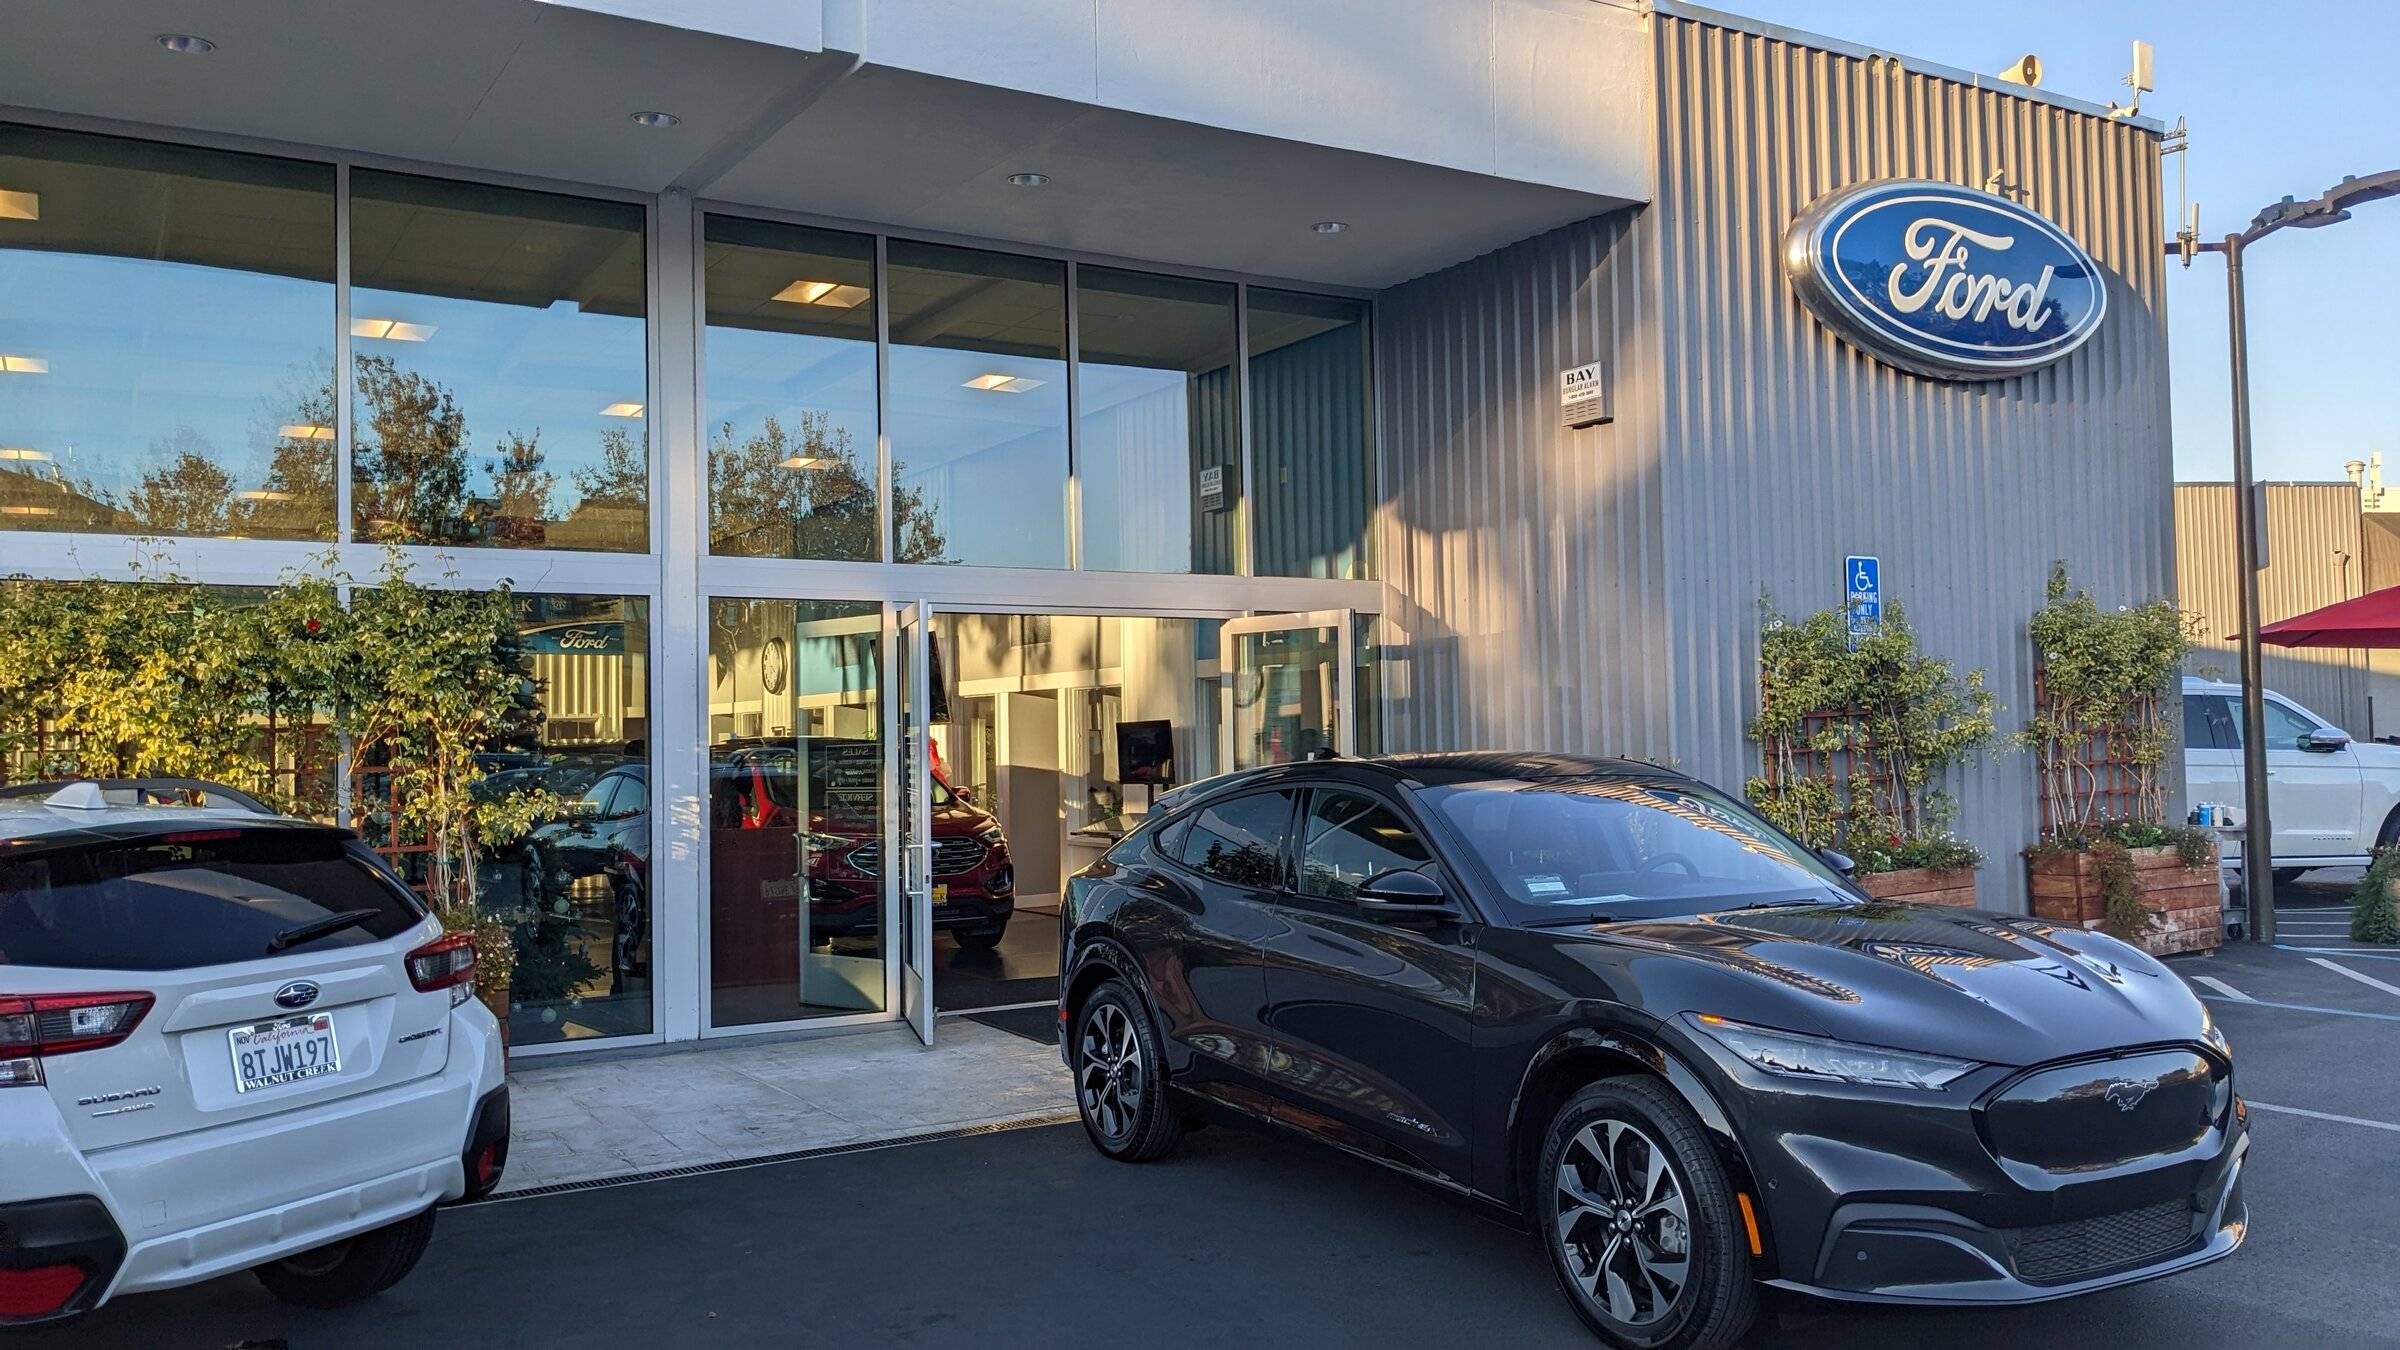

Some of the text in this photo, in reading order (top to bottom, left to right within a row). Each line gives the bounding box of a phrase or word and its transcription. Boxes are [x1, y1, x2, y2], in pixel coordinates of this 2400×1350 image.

[1888, 217, 2055, 333] Ford
[1566, 367, 1596, 385] BAY
[1850, 591, 1878, 604] PARKING
[1856, 604, 1873, 616] ONLY
[560, 629, 610, 649] Ford
[254, 1026, 315, 1045] California
[241, 1037, 329, 1080] 8TJW197
[245, 1062, 336, 1089] WALNUT CREEK
[78, 1085, 161, 1106] SUBARU
